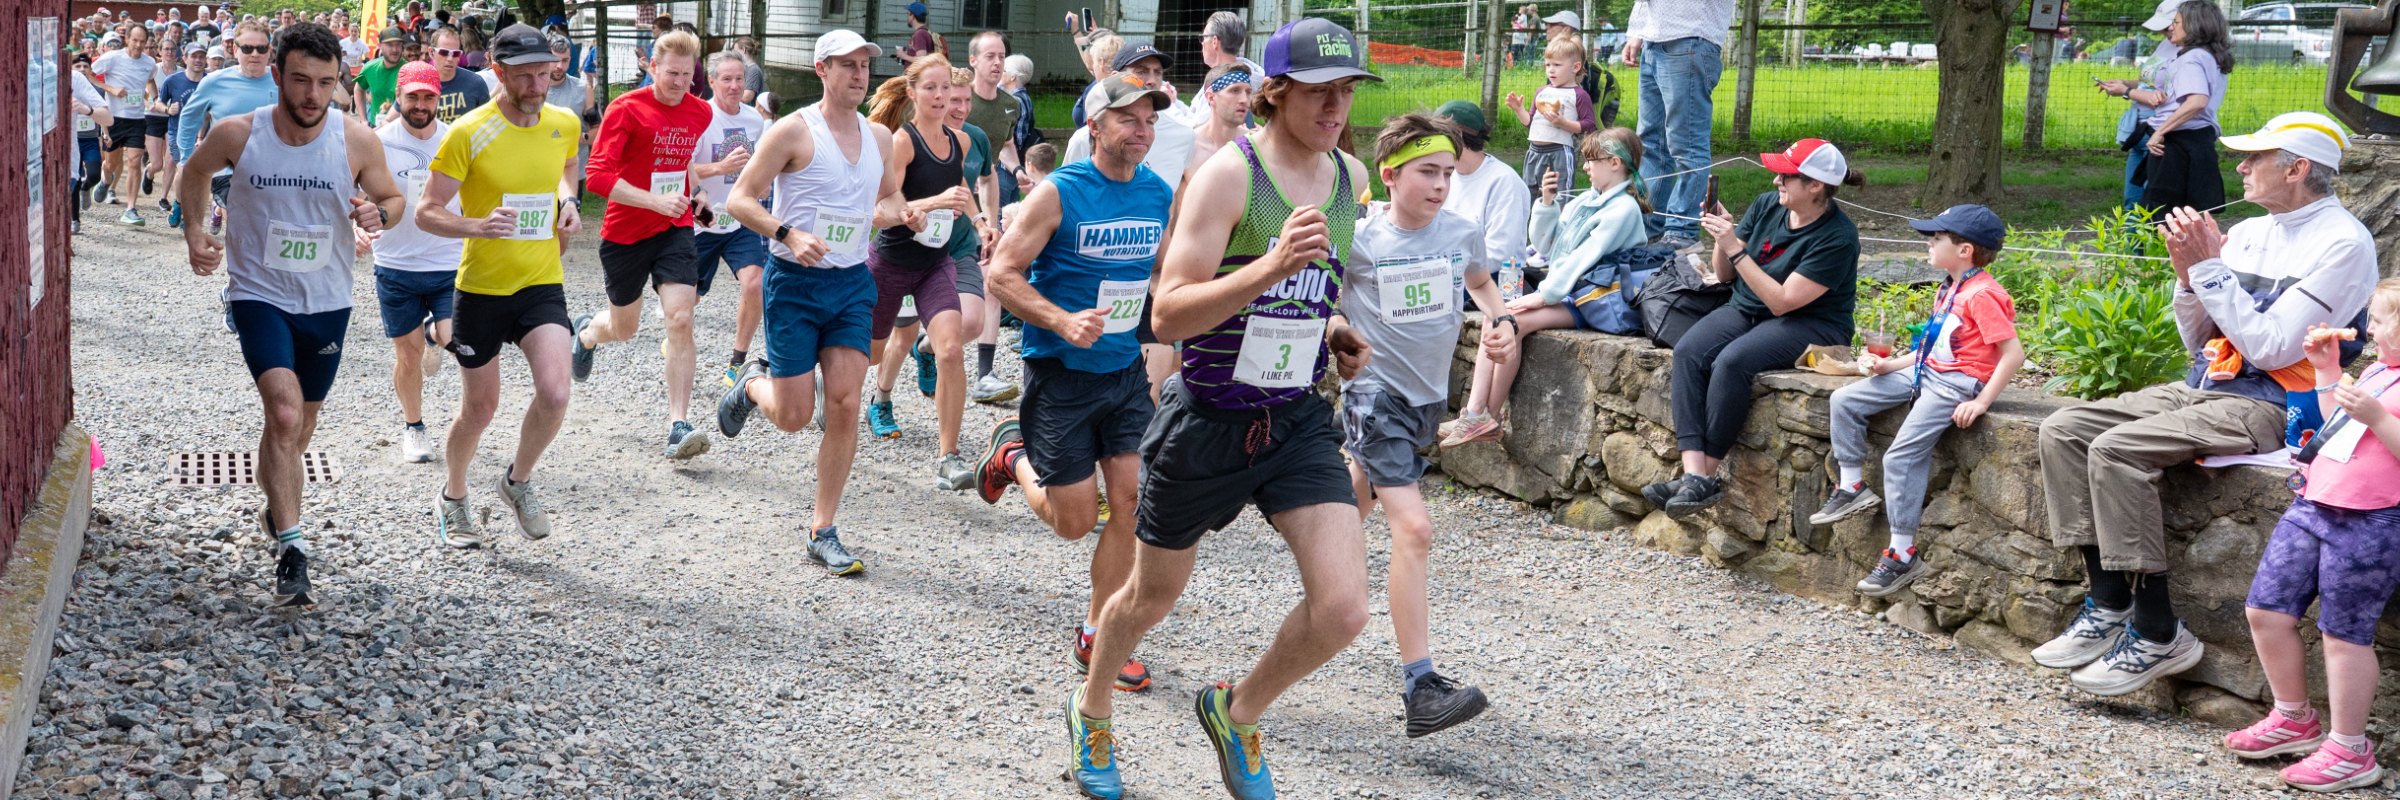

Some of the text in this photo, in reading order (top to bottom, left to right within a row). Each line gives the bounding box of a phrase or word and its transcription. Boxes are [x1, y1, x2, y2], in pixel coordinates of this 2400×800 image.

[1316, 33, 1330, 44] PLT
[1318, 39, 1352, 58] racing
[653, 131, 697, 146] bedford
[652, 145, 680, 156] turkey
[249, 173, 334, 191] Quinnipiac
[825, 223, 856, 243] 197
[933, 221, 941, 238] 2
[1083, 226, 1162, 247] HAMMER
[279, 239, 317, 261] 203
[1103, 246, 1151, 257] NUTRITION
[1404, 282, 1431, 307] 95
[1109, 298, 1142, 320] 222
[1392, 302, 1444, 318] HAPPYBIRTHDAY
[1274, 343, 1292, 371] 3
[1261, 370, 1295, 381] I LIKE PIE
